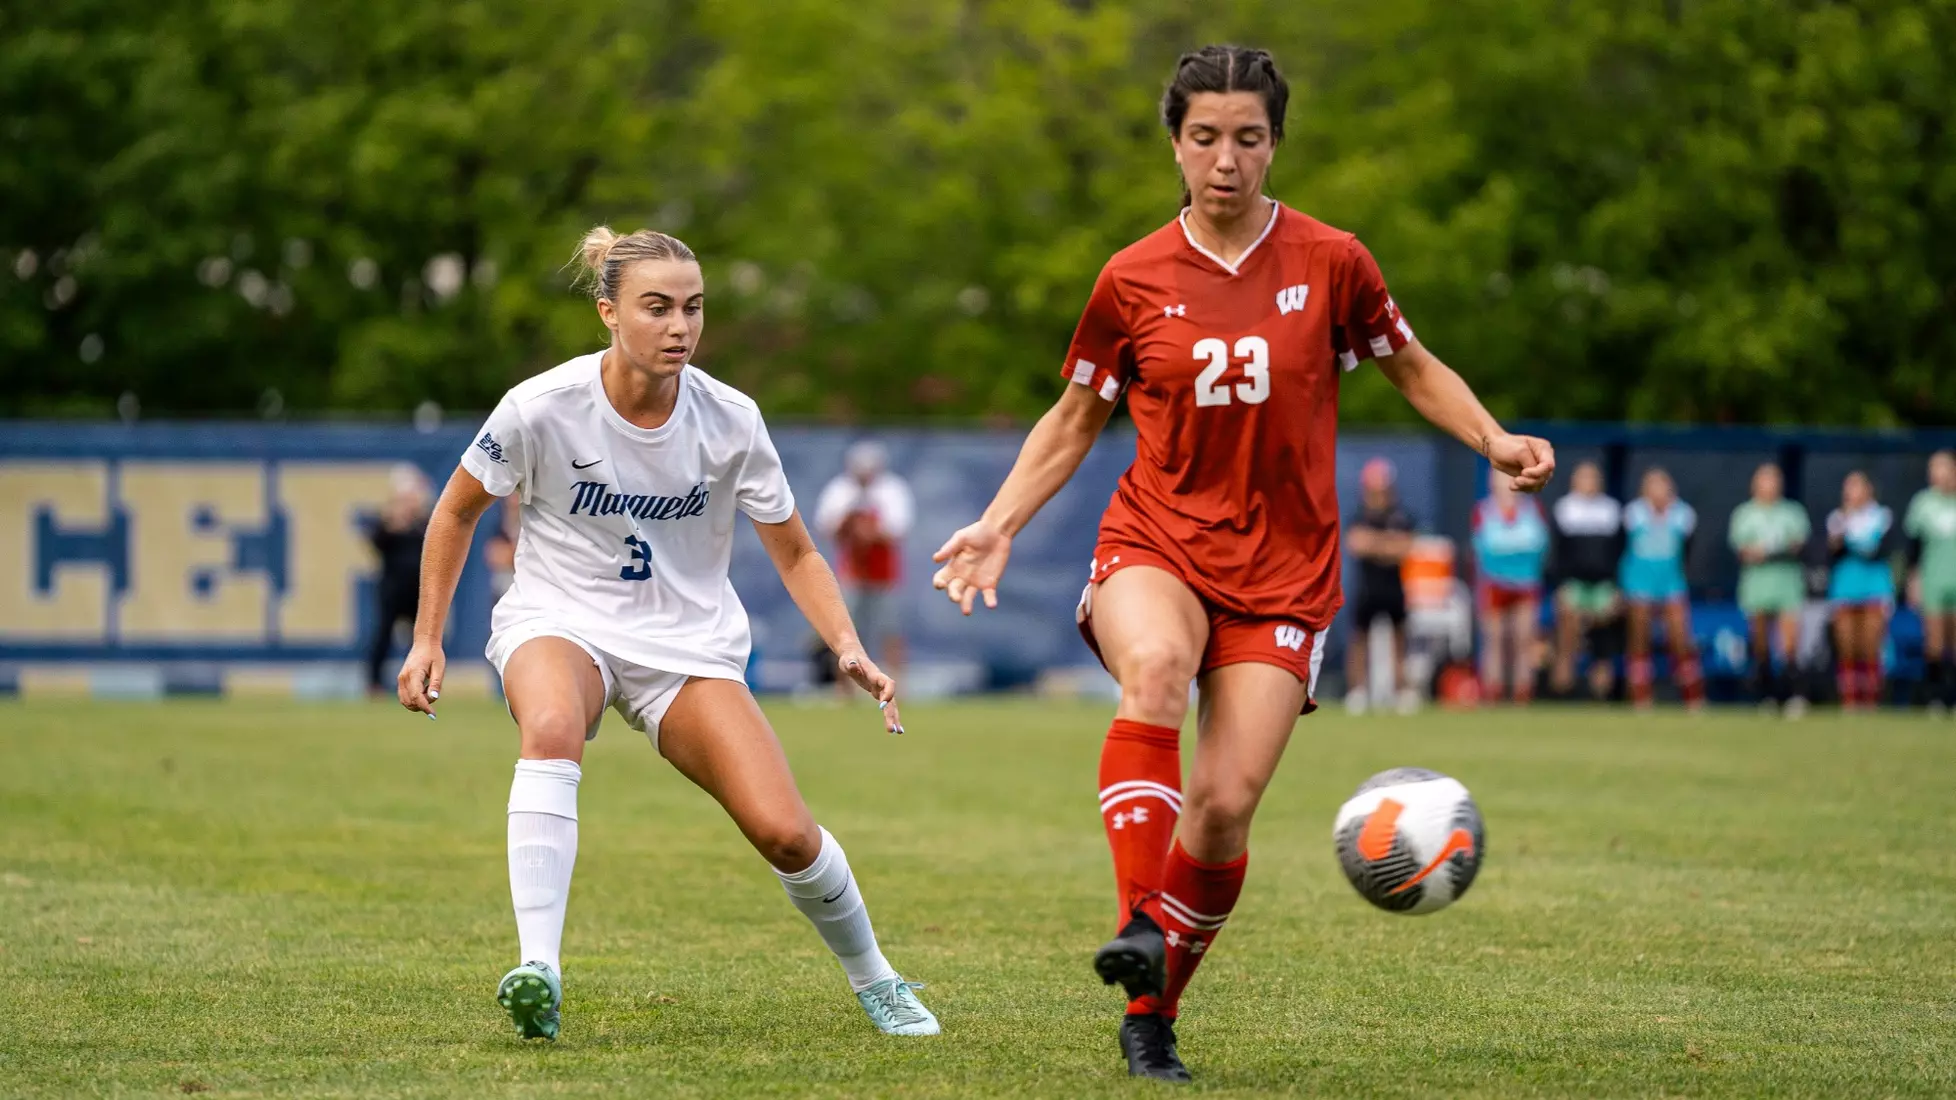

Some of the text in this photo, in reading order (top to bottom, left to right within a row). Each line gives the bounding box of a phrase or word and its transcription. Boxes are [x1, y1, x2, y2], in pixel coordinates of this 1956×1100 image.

[1276, 284, 1309, 316] W
[1193, 335, 1270, 407] 23
[619, 534, 652, 580] 3
[1274, 625, 1306, 652] W
